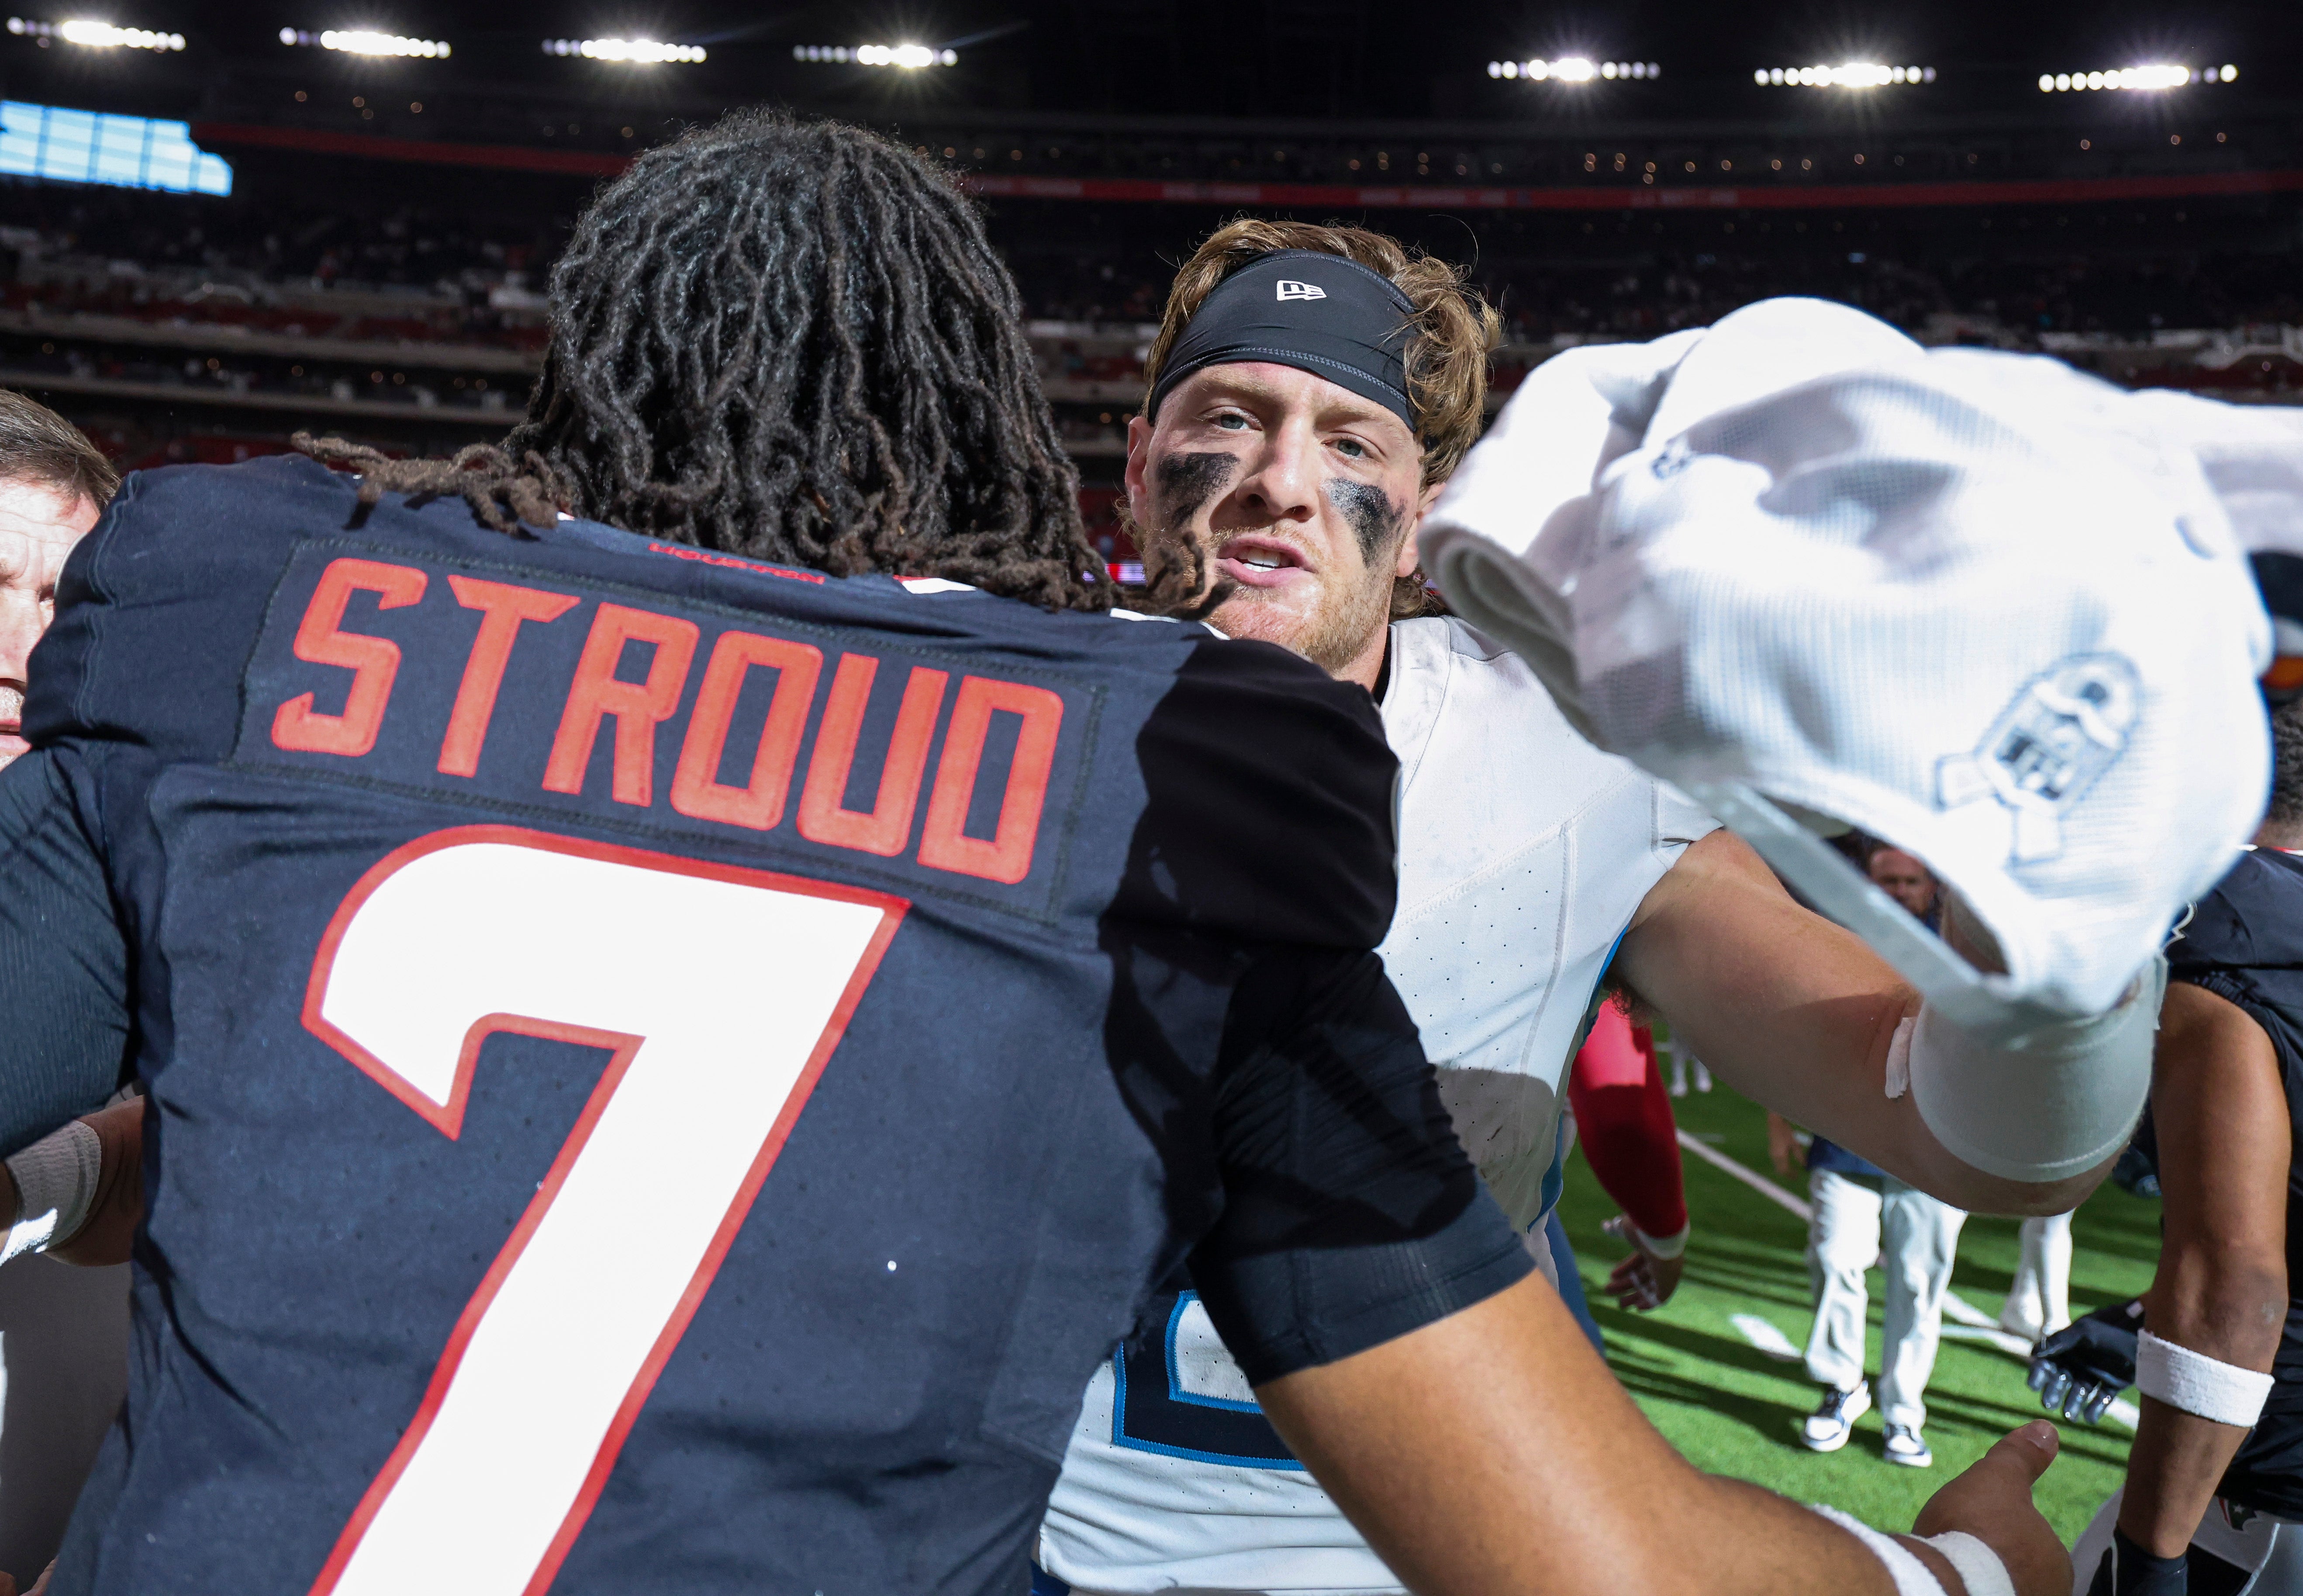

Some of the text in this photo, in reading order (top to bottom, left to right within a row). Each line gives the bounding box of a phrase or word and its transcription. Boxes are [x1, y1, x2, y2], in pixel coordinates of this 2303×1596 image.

[270, 557, 1065, 885] STROUD
[648, 542, 825, 584] HOUSTON
[300, 824, 912, 1596] 7
